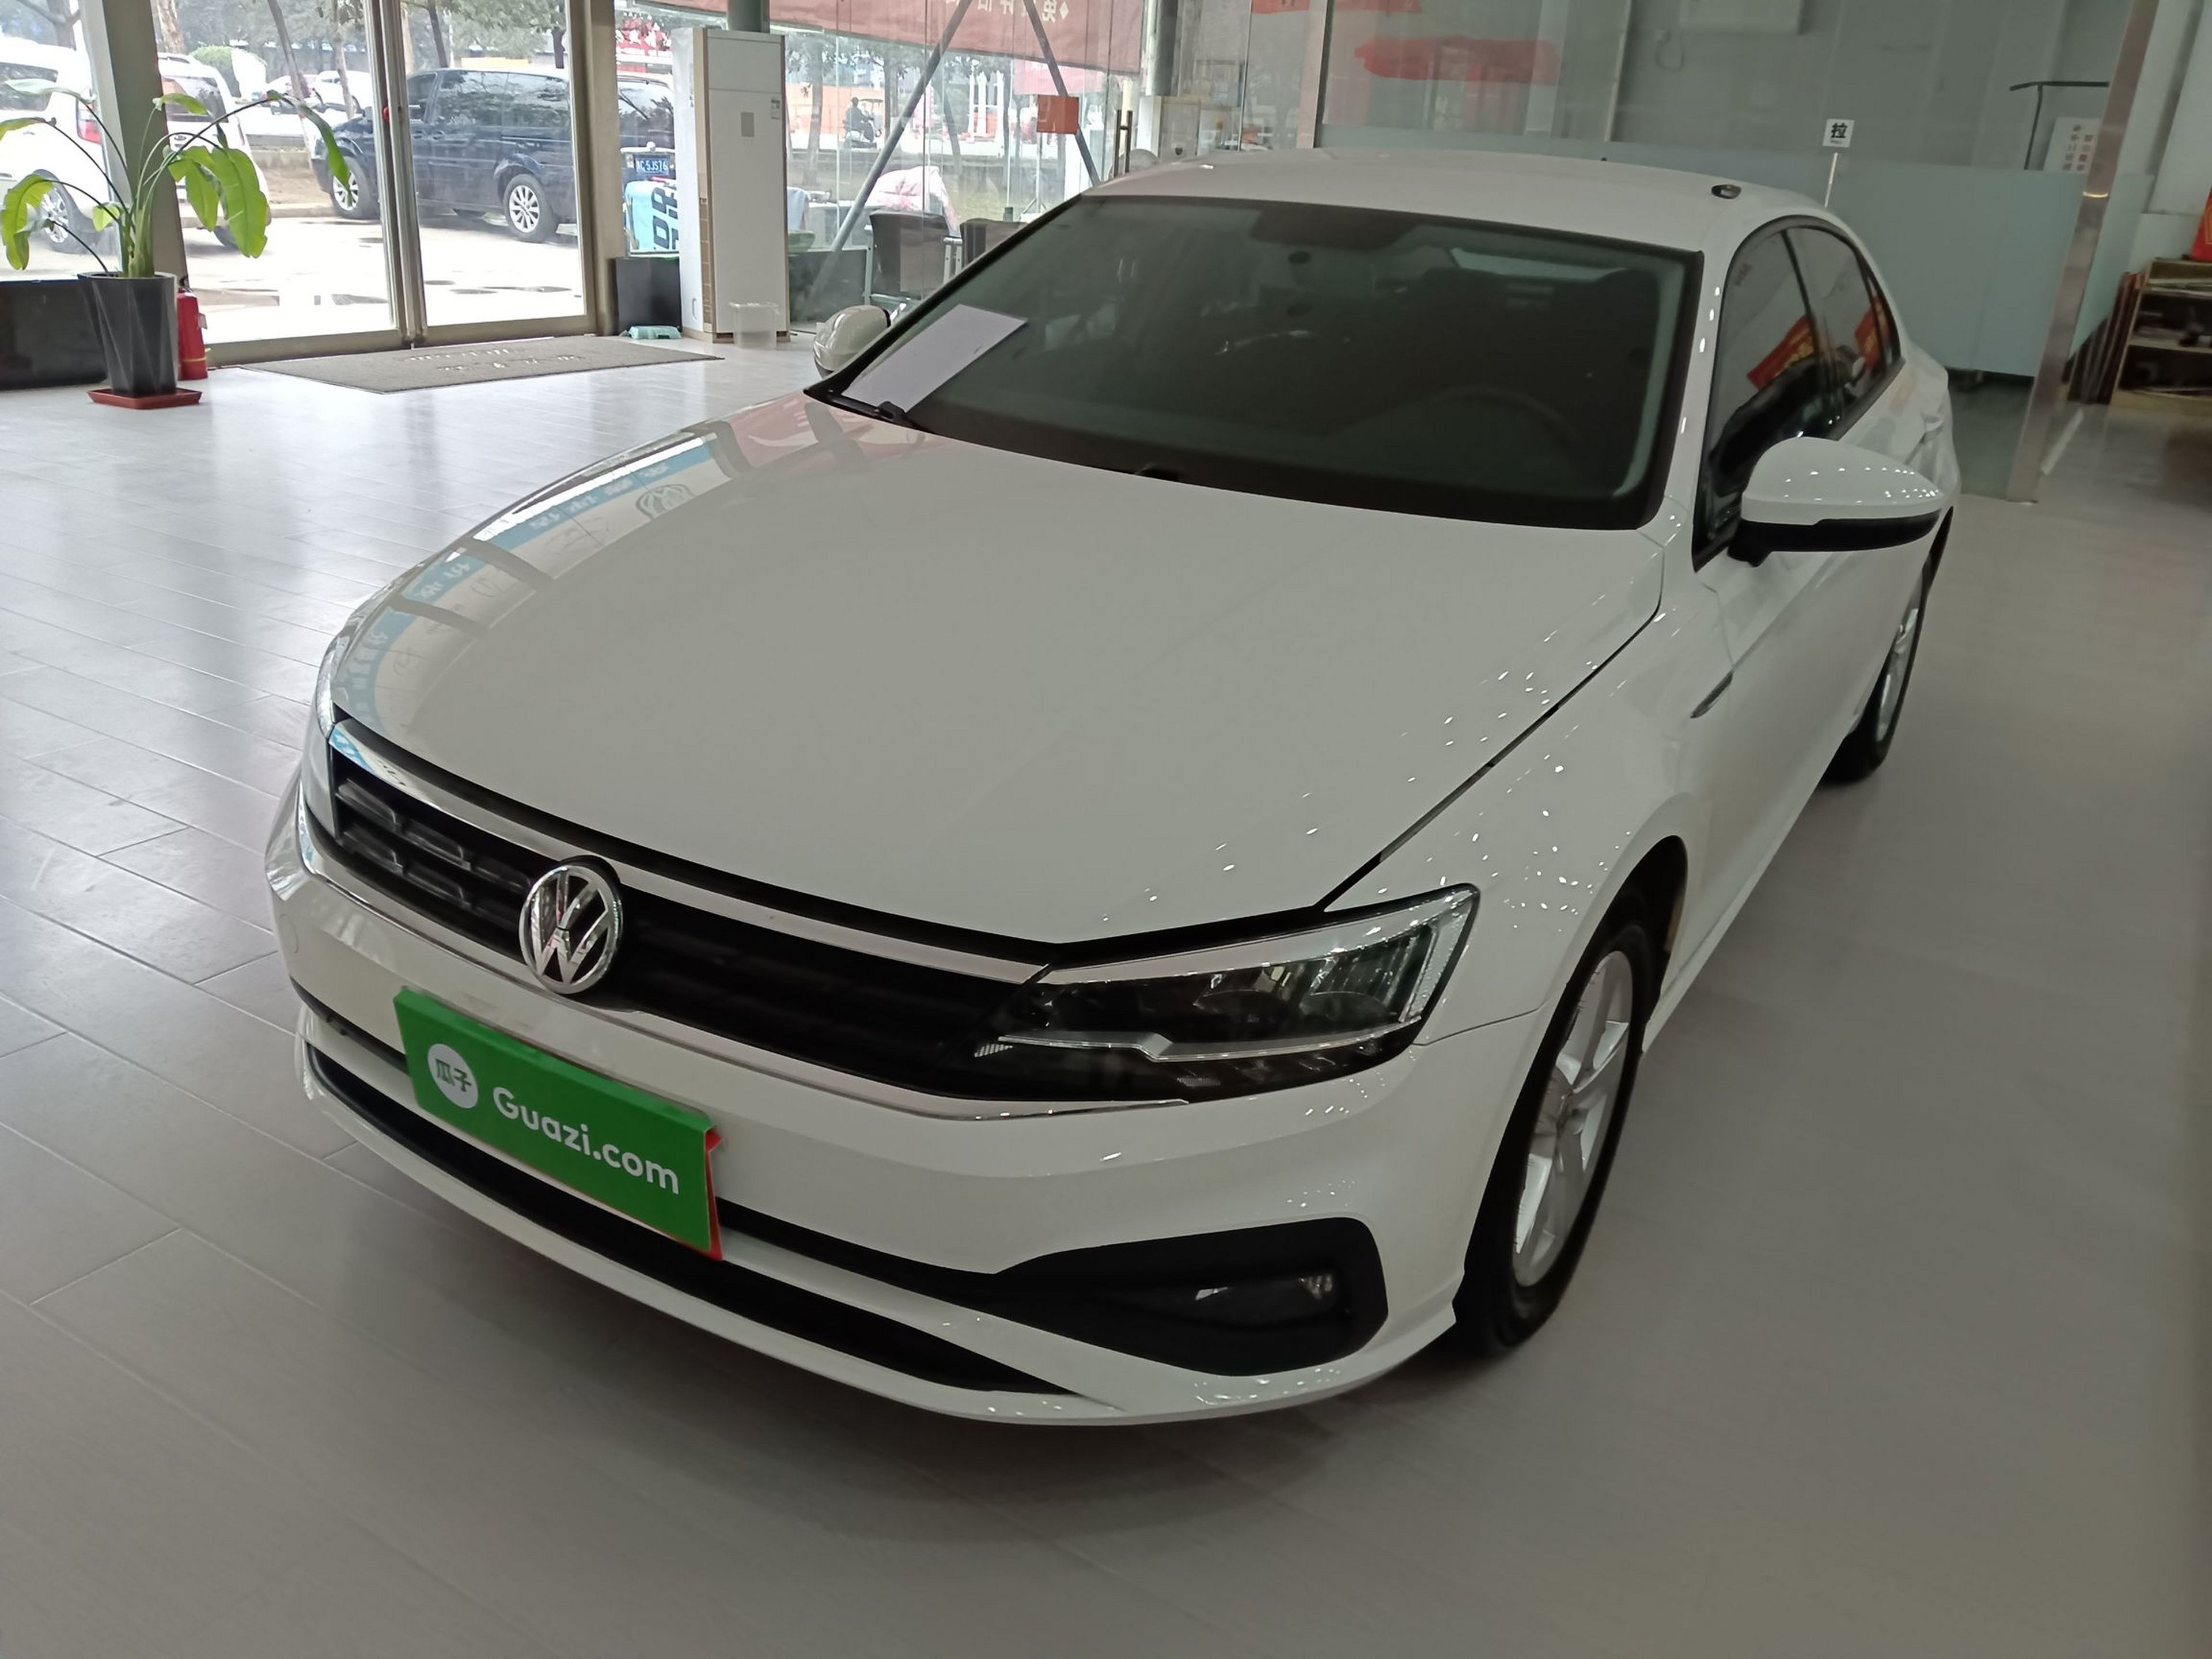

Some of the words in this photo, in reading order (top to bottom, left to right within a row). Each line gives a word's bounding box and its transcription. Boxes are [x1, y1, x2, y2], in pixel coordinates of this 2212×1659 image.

[1831, 122, 1848, 139] 拉
[520, 866, 622, 993] VW
[435, 1058, 472, 1092] 瓜子
[493, 1086, 680, 1195] Guazi.com
